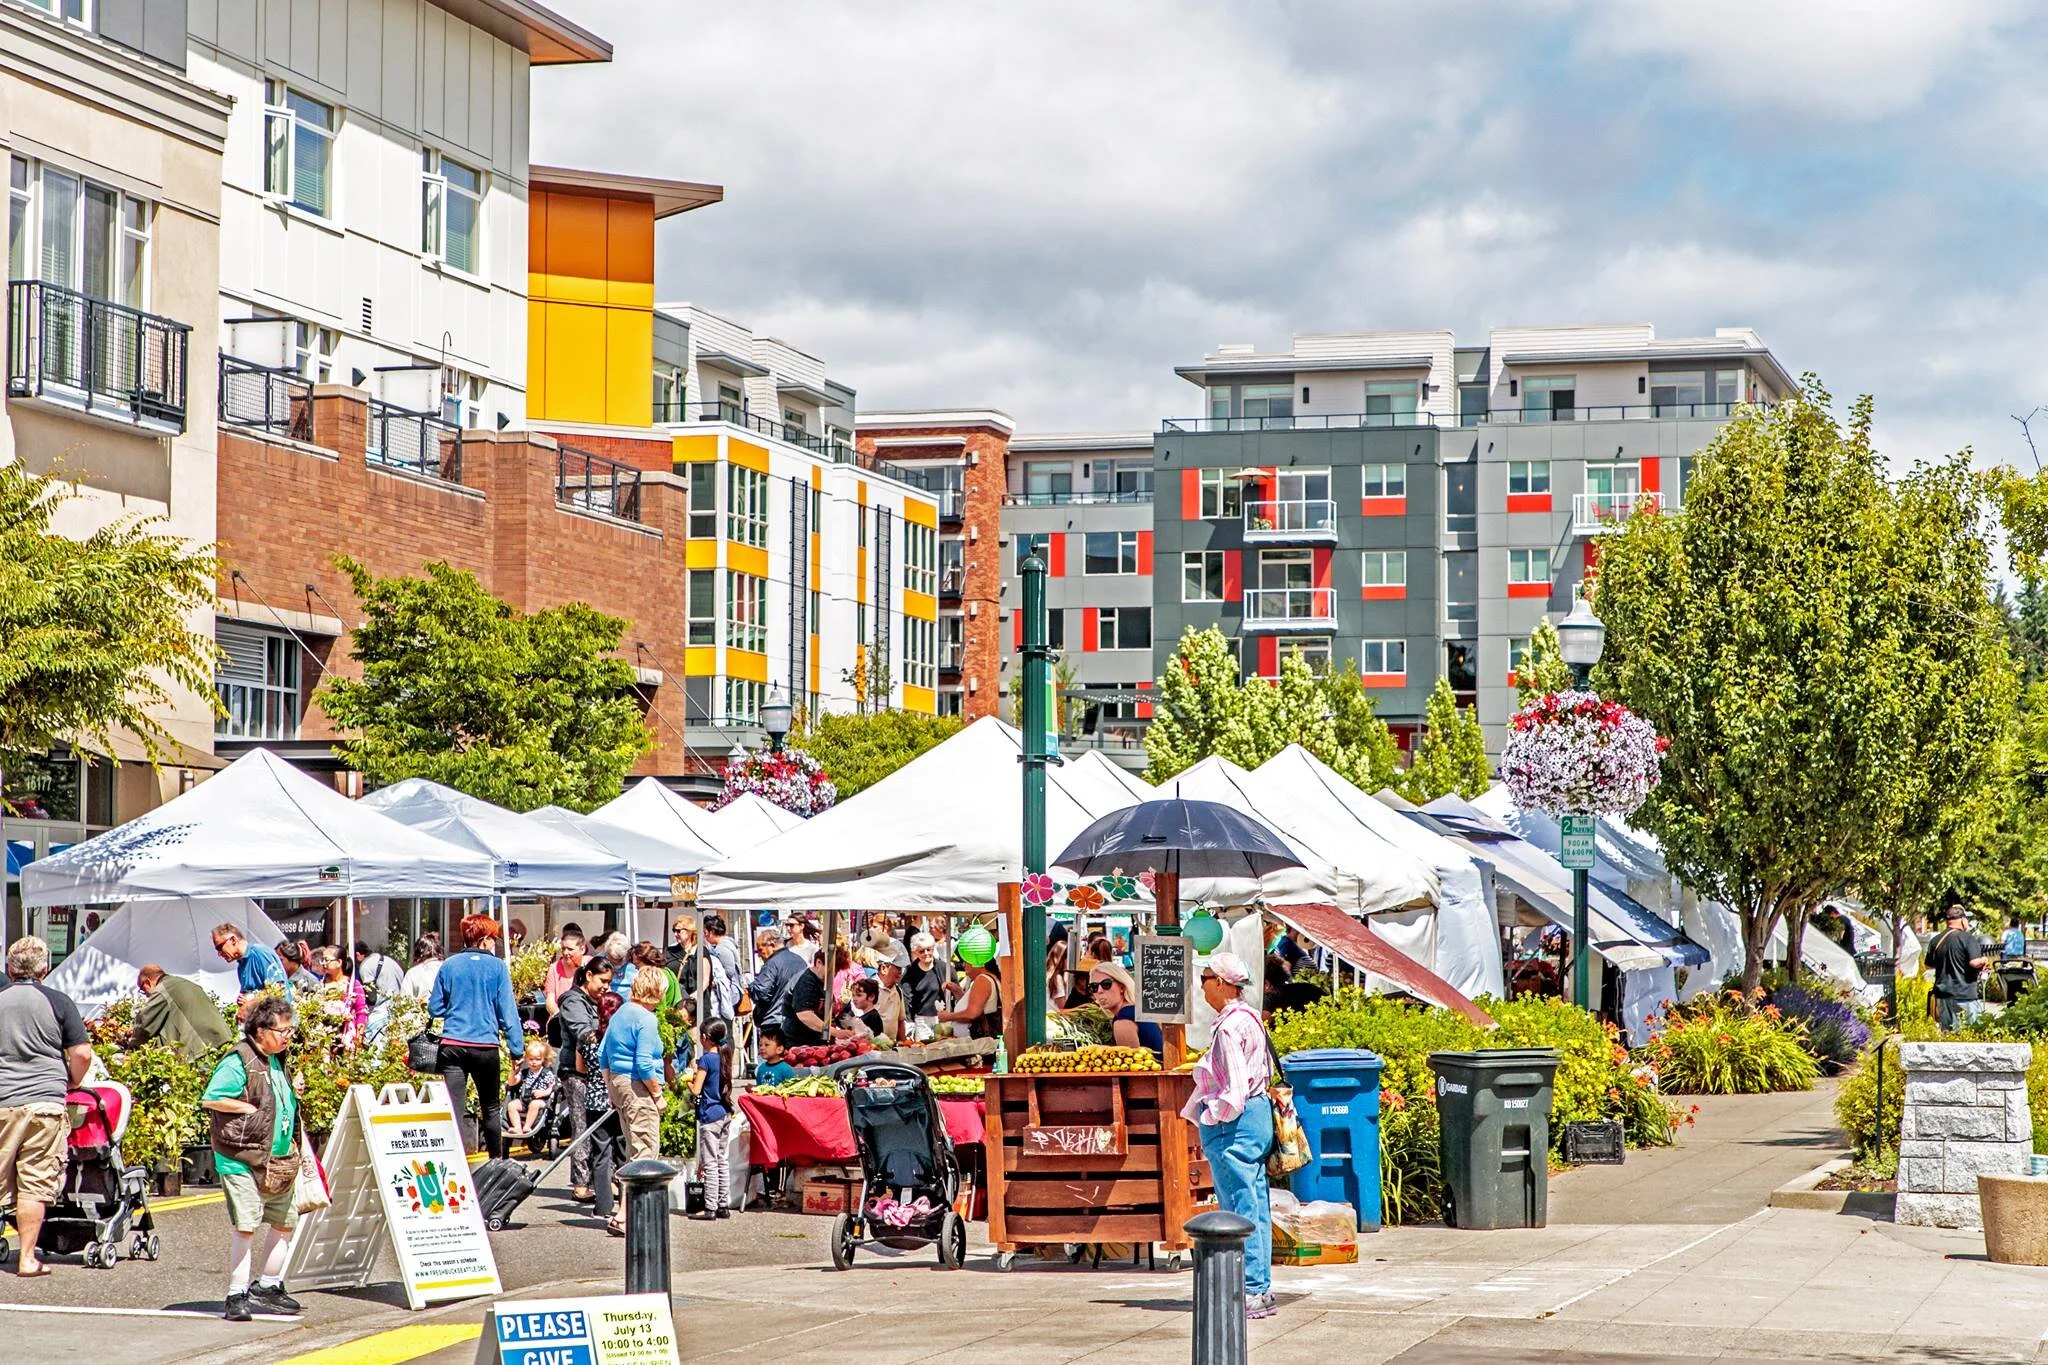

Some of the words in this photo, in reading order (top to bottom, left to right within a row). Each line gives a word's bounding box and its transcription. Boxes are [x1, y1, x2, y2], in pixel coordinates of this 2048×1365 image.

[25, 774, 52, 791] 16177
[1563, 819, 1571, 833] 2
[298, 920, 304, 932] &
[305, 919, 325, 933] Nuts!
[1144, 944, 1165, 955] Fresh
[1143, 955, 1152, 964] Is
[1153, 955, 1169, 965] Fast
[1169, 955, 1184, 966] Food
[1143, 965, 1157, 976] Free
[1157, 965, 1183, 978] Banana
[1144, 977, 1157, 988] For
[1147, 997, 1178, 1010] Burien
[1446, 1082, 1468, 1094] GARBAGE
[401, 1129, 417, 1138] WHAT
[419, 1128, 428, 1137] DO
[391, 1140, 410, 1149] FRESH
[411, 1138, 429, 1148] BUCKS
[430, 1137, 445, 1147] BUY?
[603, 1311, 657, 1323] Thursday,
[501, 1312, 585, 1340] PLEASE
[613, 1325, 636, 1337] July
[640, 1323, 652, 1334] 13
[601, 1339, 630, 1350] 10:00
[633, 1338, 644, 1348] to
[646, 1335, 669, 1347] 4:00
[523, 1349, 574, 1365] GIVE
